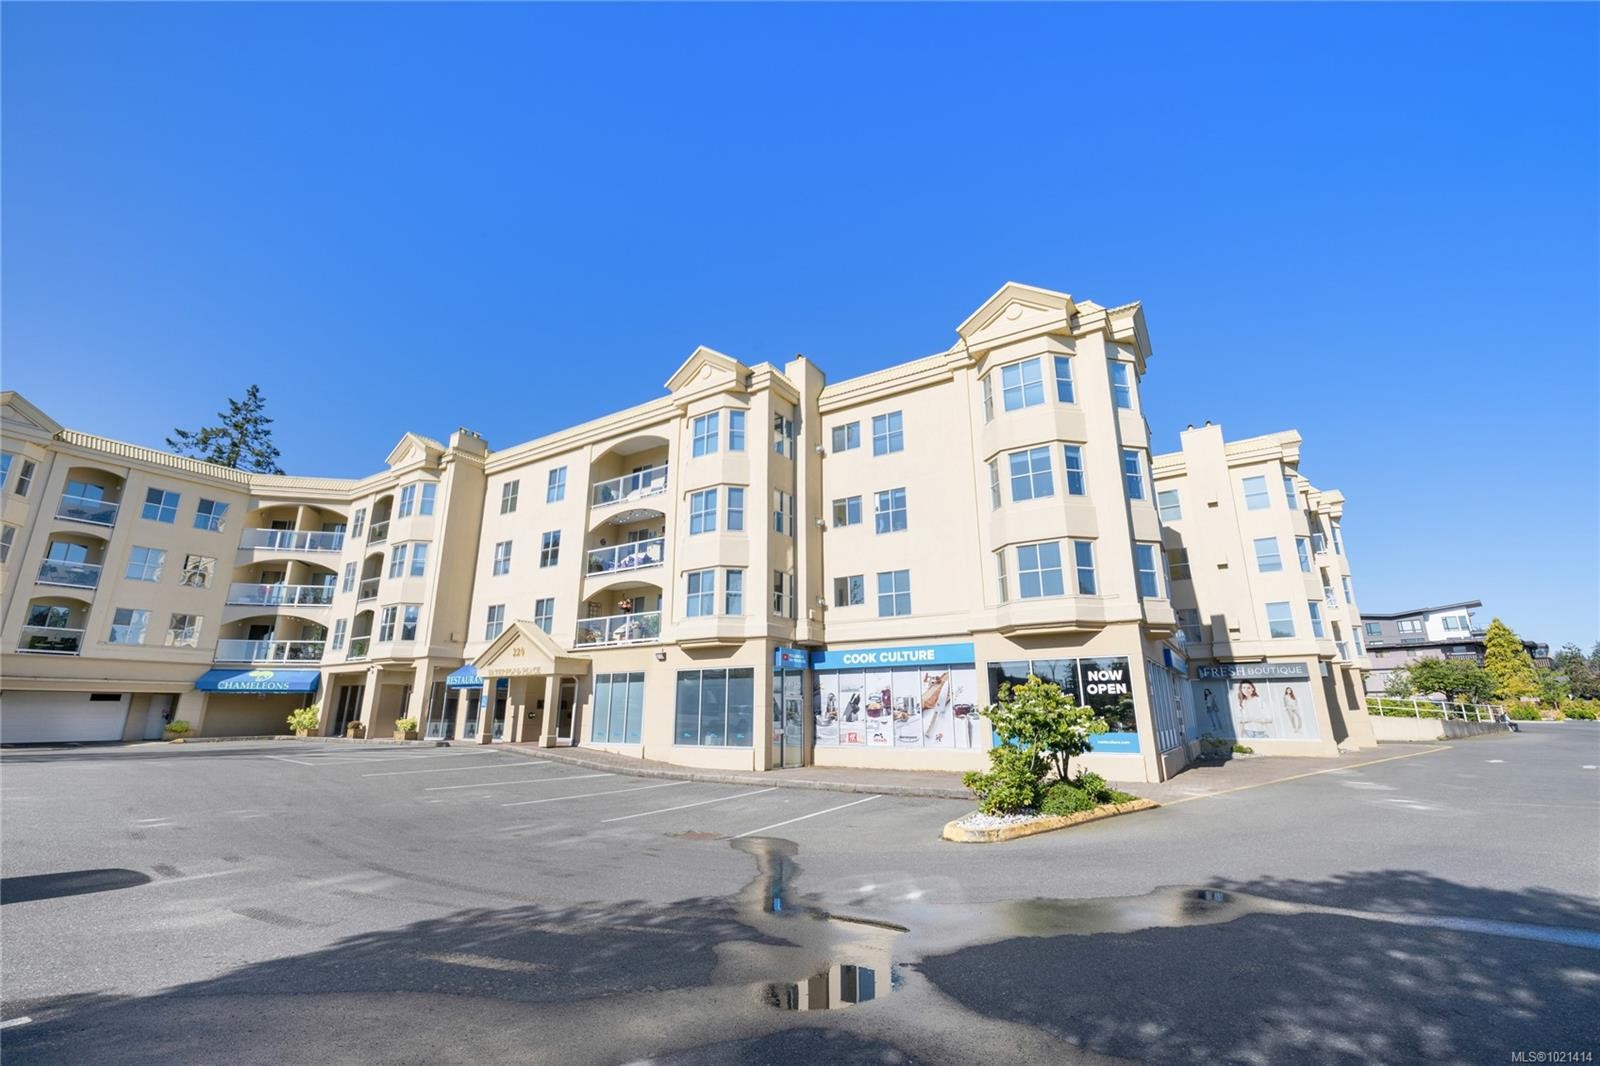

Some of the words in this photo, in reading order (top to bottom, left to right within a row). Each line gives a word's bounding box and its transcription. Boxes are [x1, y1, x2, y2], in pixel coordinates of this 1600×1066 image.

[843, 654, 876, 664] COOK
[880, 649, 935, 661] CULTURE
[1087, 670, 1124, 682] NOW
[1249, 666, 1303, 676] BOUTIQUE
[217, 681, 289, 689] CHAMELEONS
[1086, 683, 1127, 695] OPEN
